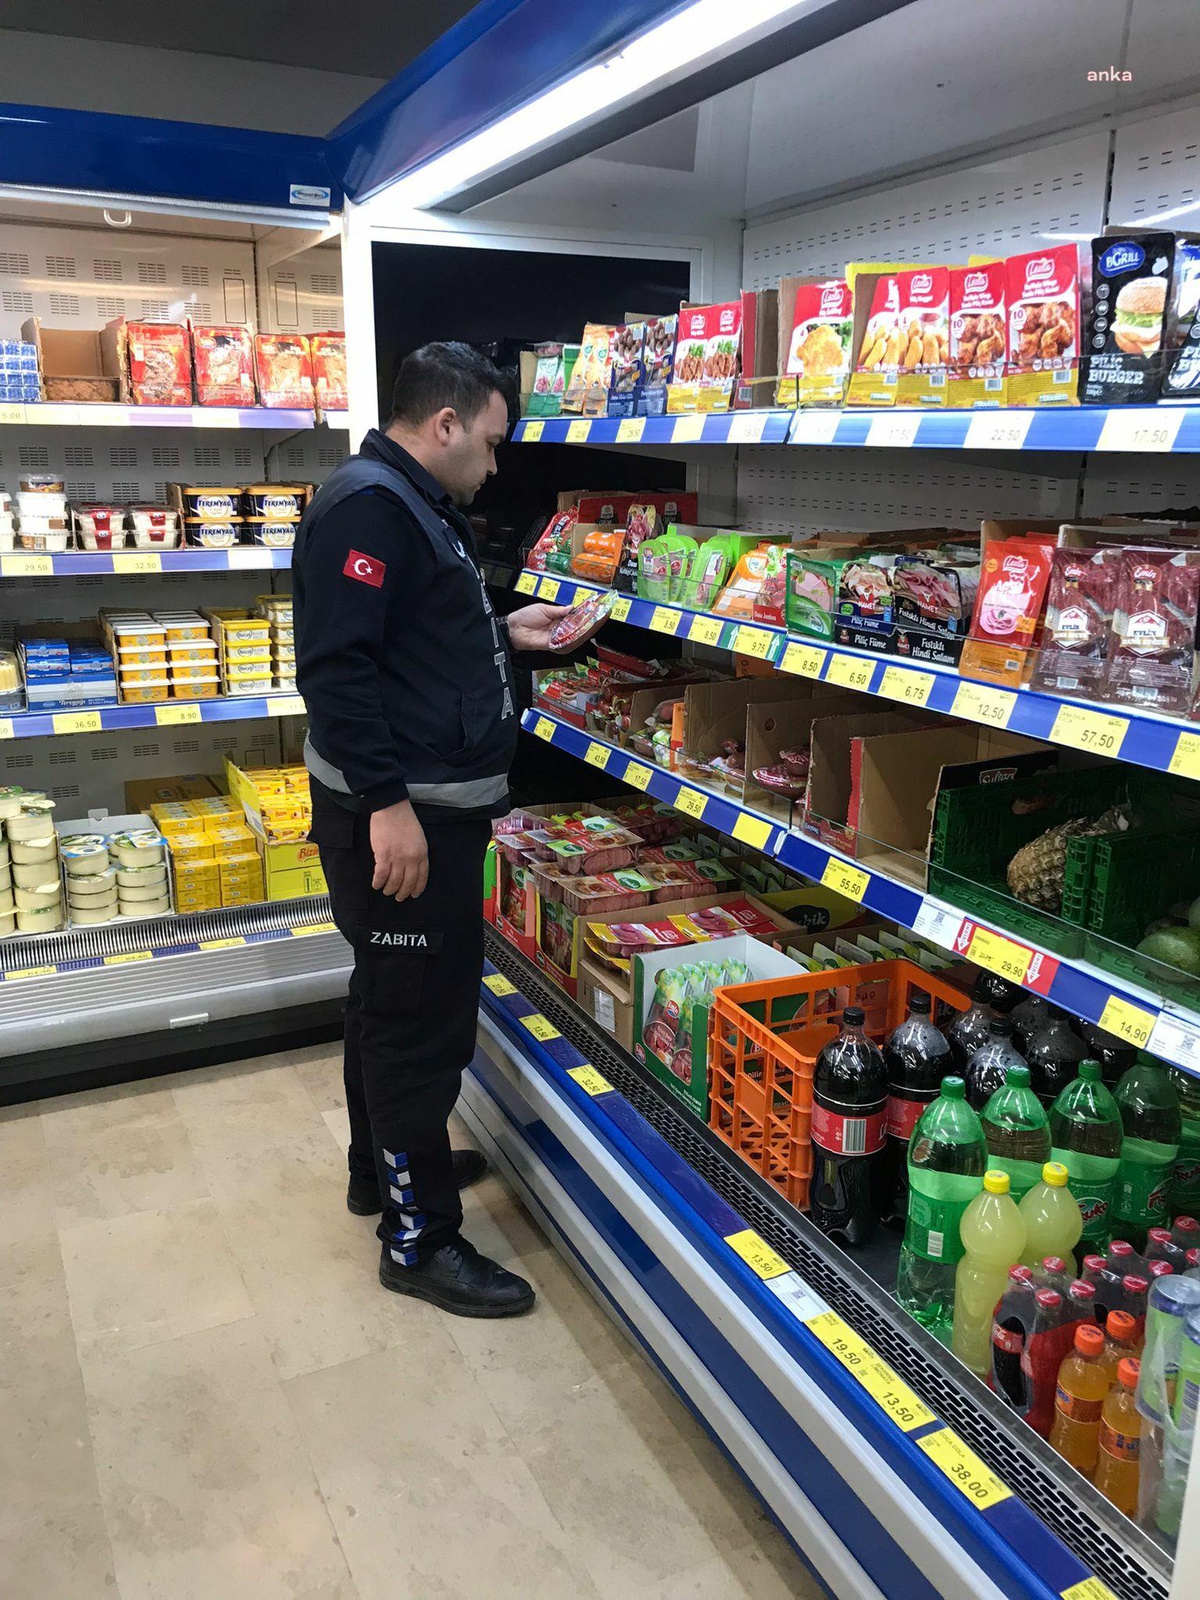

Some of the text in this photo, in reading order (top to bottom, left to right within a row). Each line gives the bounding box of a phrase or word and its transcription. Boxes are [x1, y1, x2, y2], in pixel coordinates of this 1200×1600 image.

[1013, 308, 1024, 320] 10
[1088, 369, 1144, 385] BURGER
[1133, 567, 1157, 579] Emin
[854, 634, 887, 649] Piliç Füme
[912, 646, 955, 664] Hindi Salam
[904, 686, 925, 700] 6,75
[977, 703, 1005, 720] 12,50
[1081, 729, 1115, 749] 57,50
[840, 878, 861, 896] 55,50
[370, 931, 428, 947] ZABITA
[1001, 960, 1023, 978] 29,90
[1120, 1021, 1147, 1042] 14,90
[751, 1253, 774, 1273] 13,50
[832, 1338, 862, 1366] 19,50
[882, 1391, 915, 1423] 13,50
[951, 1463, 989, 1499] 38,00
